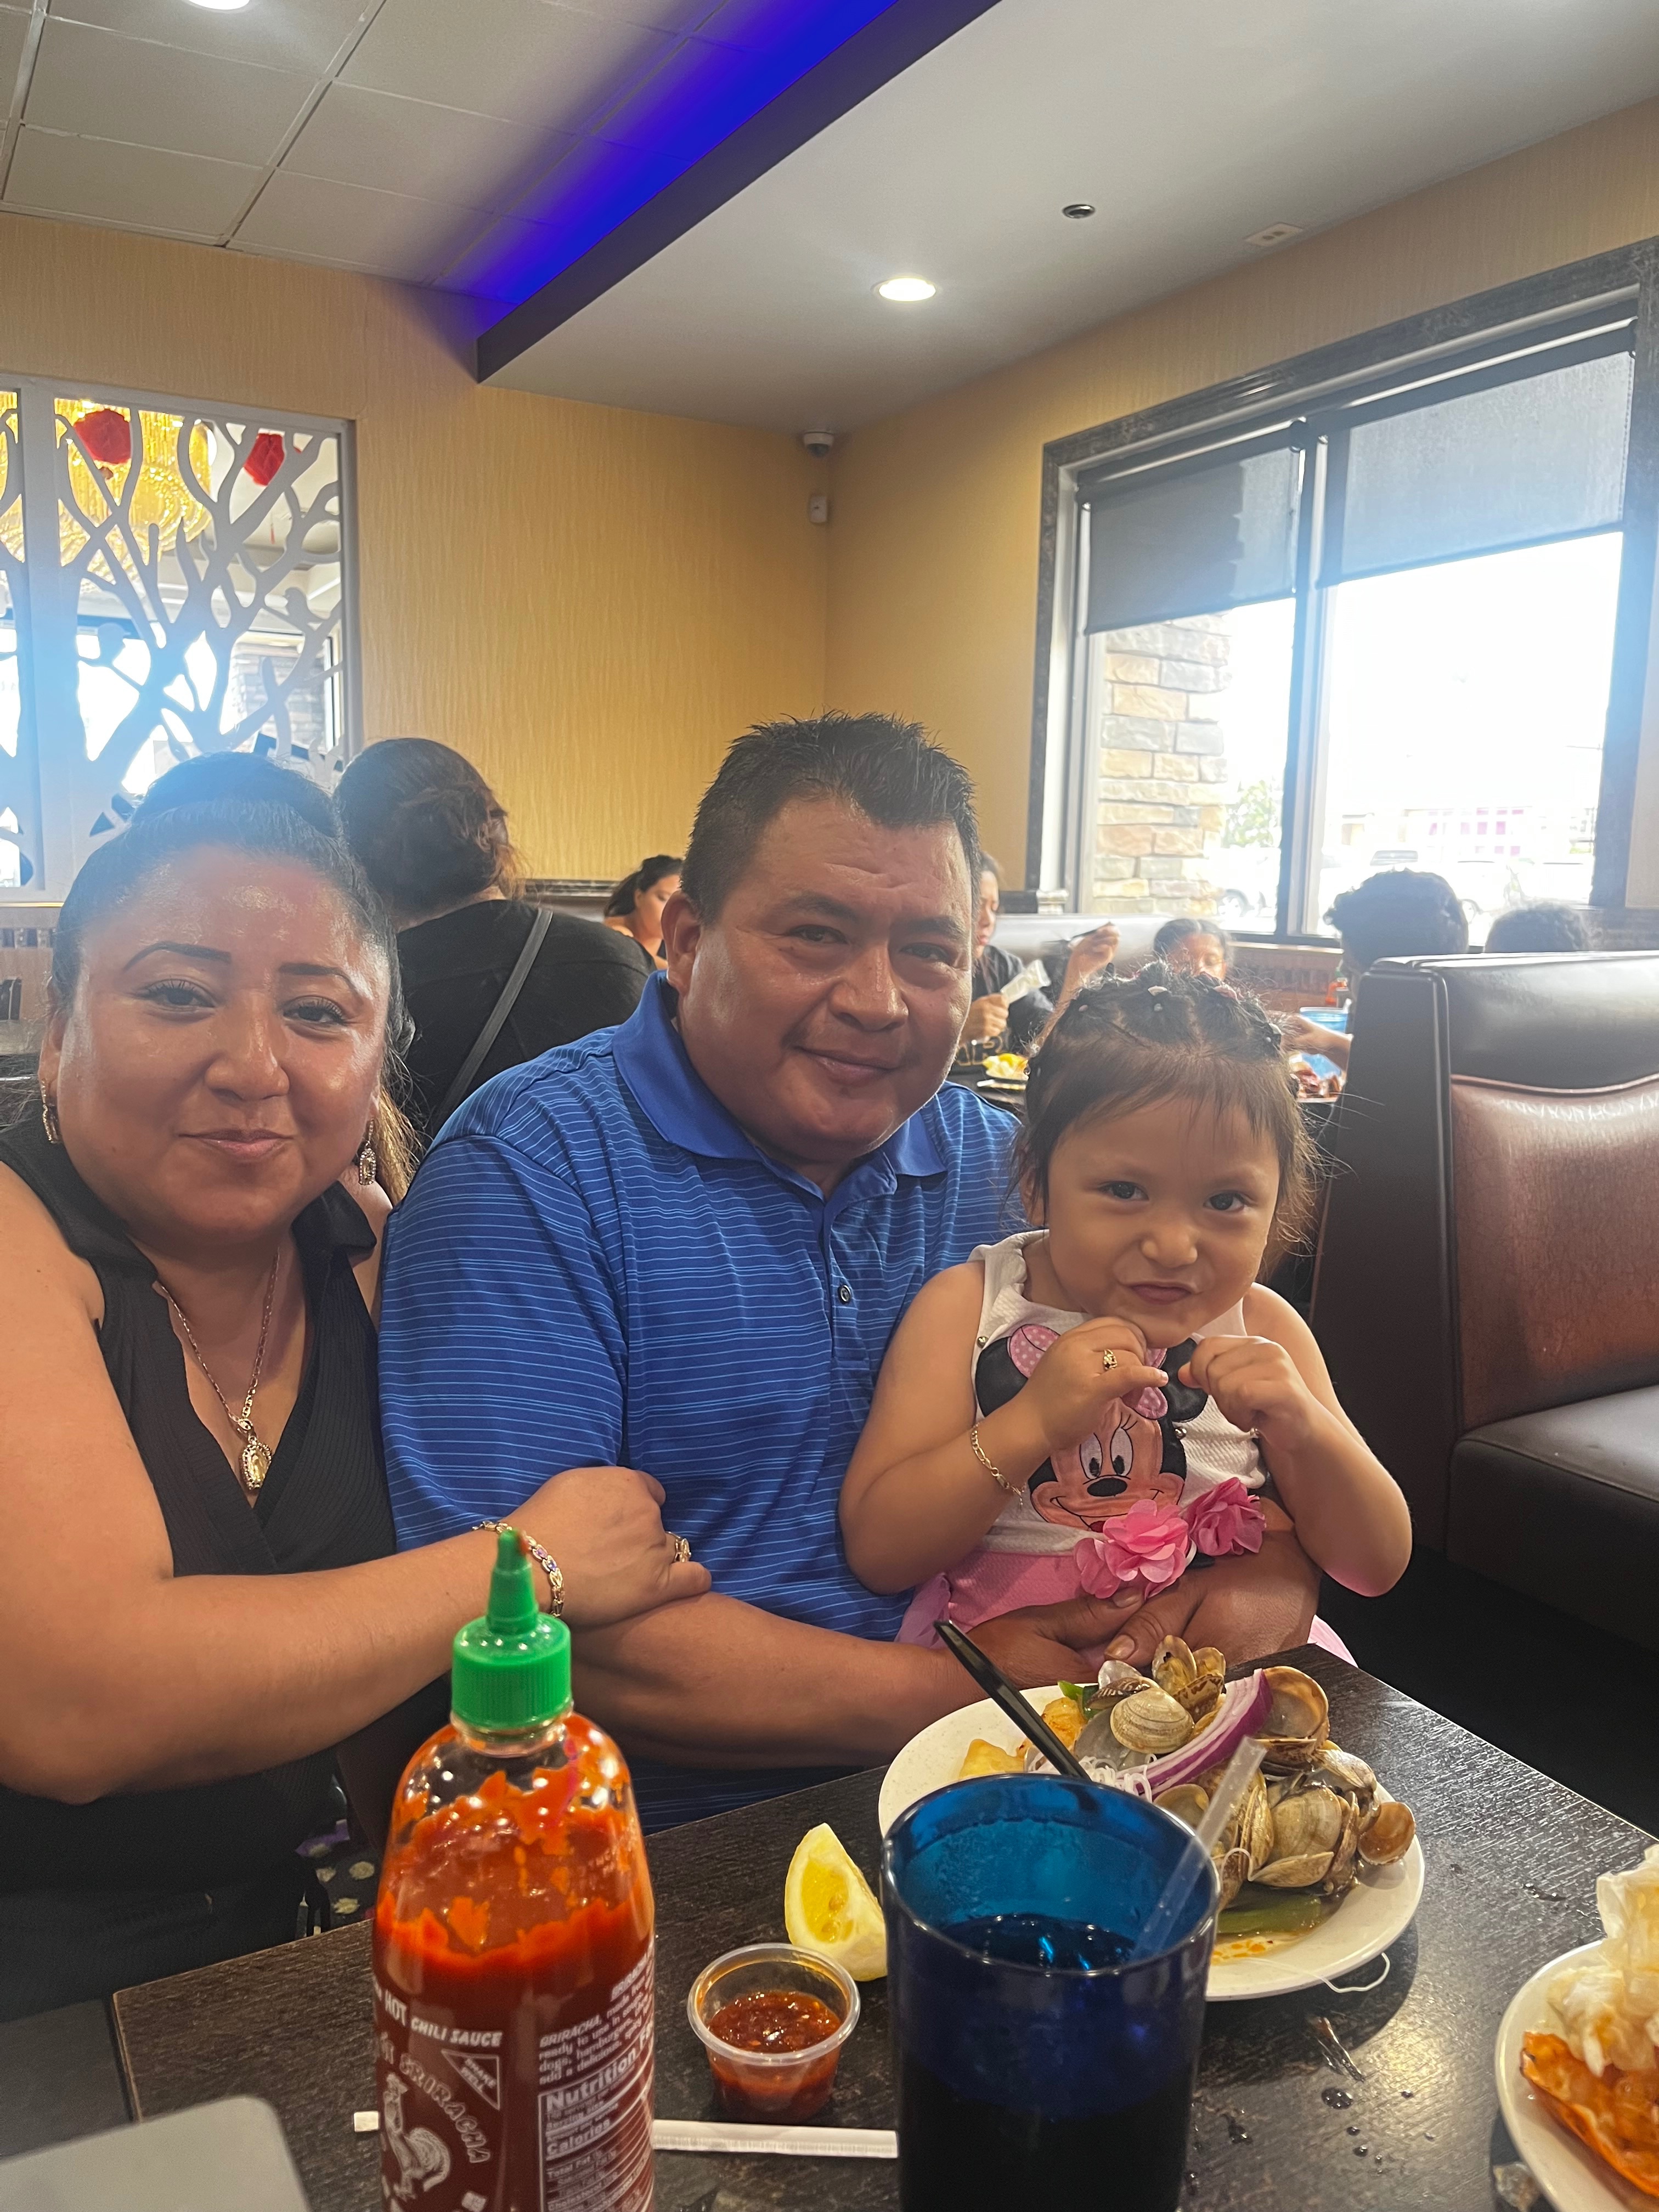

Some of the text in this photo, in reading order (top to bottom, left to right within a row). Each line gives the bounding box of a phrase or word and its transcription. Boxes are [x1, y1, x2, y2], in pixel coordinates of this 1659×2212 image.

[385, 1989, 503, 2047] HOT CHILI SAUCE
[547, 2048, 636, 2112] Nutrition
[547, 2119, 610, 2155] Calories
